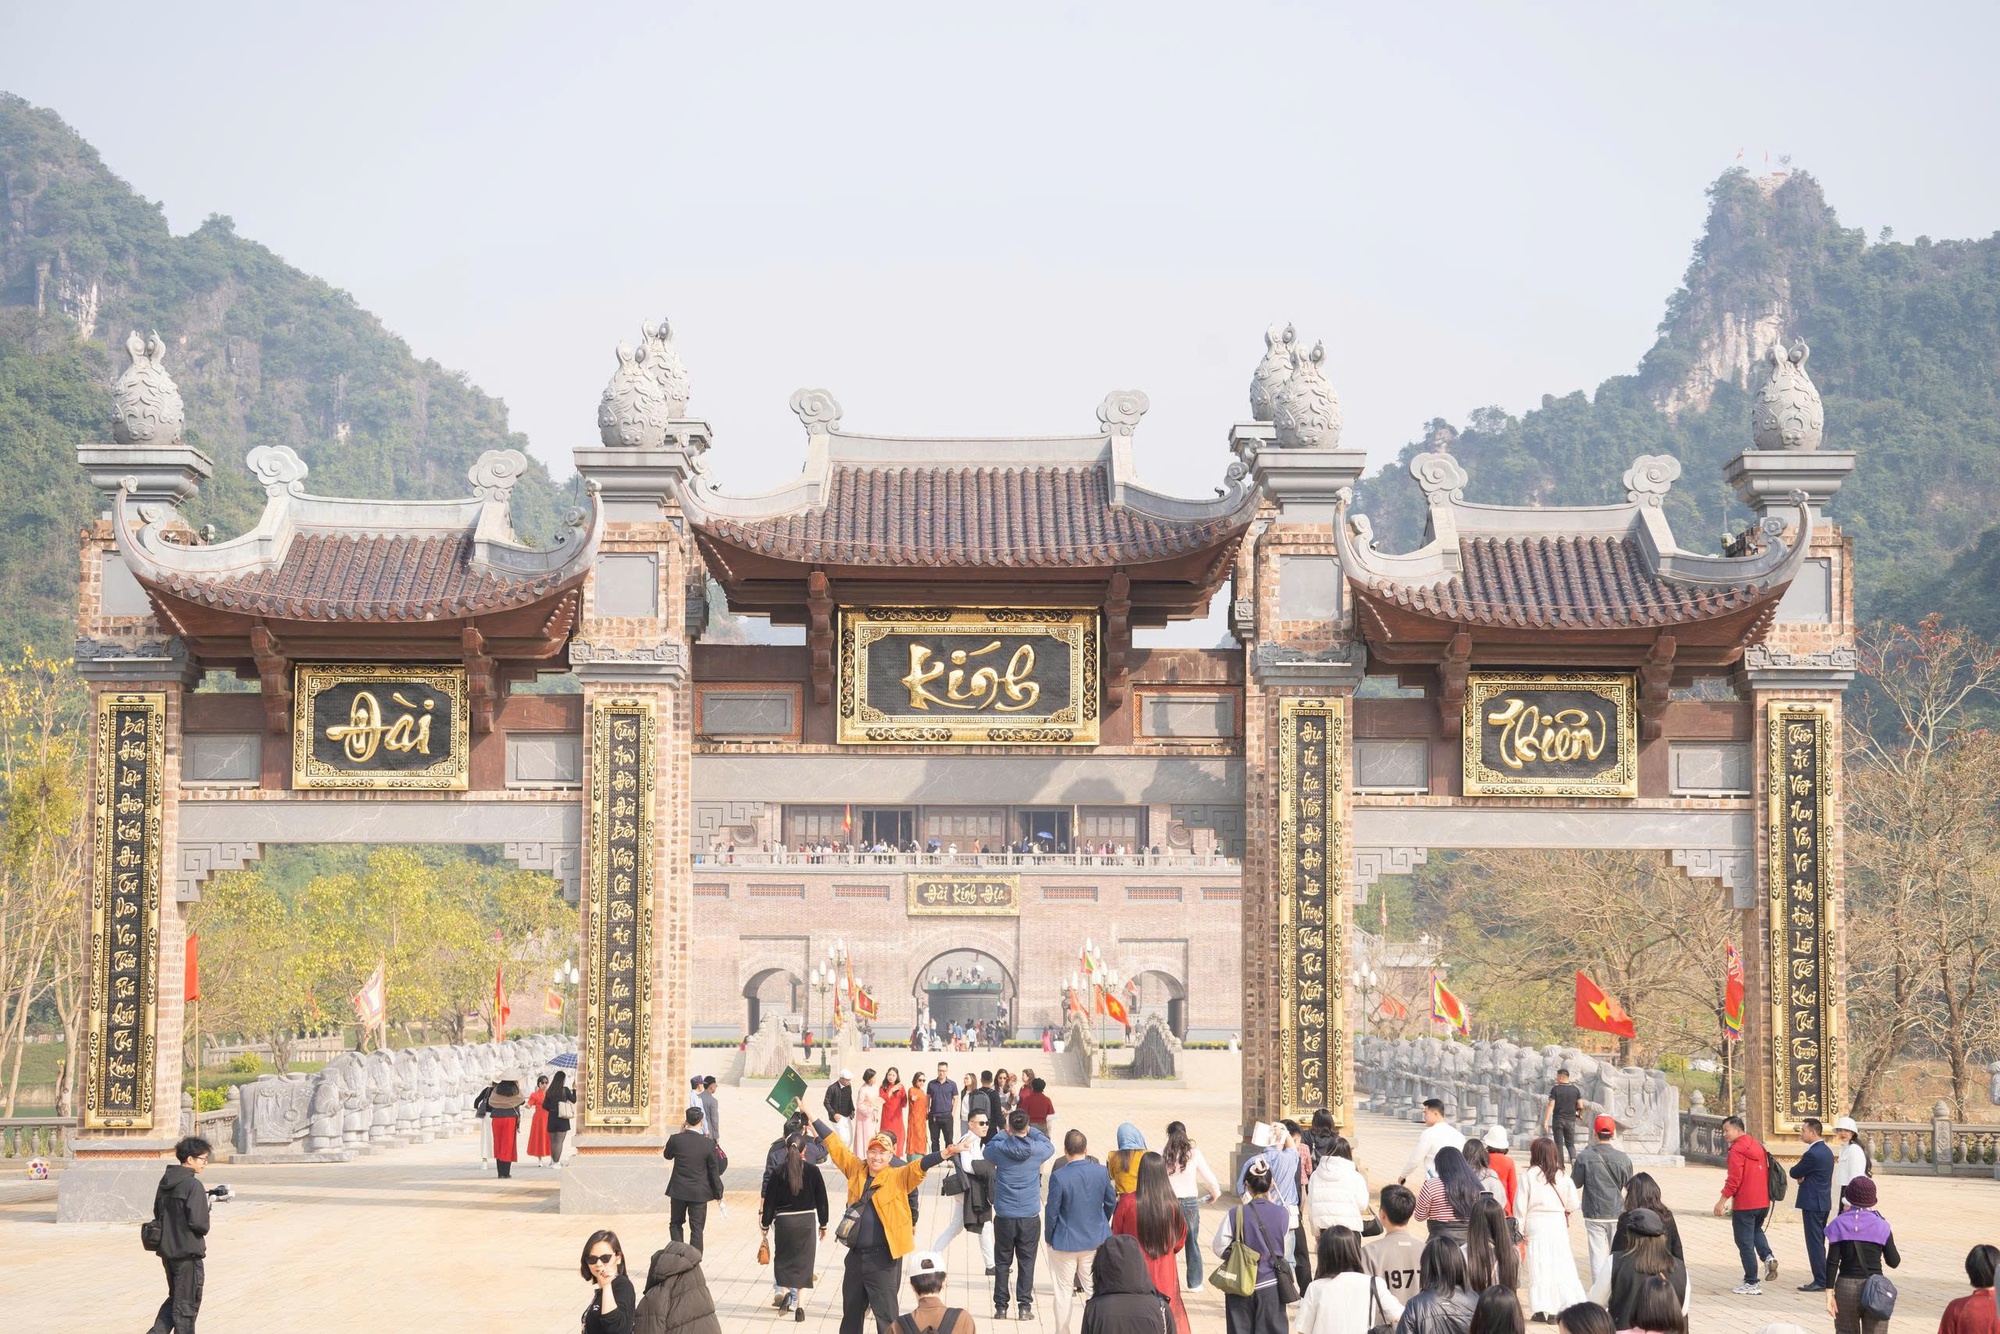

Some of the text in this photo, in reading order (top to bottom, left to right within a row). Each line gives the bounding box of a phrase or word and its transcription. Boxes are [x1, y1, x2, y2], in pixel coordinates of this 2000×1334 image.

[901, 641, 1040, 711] Kính
[121, 716, 145, 736] Bái
[326, 691, 435, 762] Đài
[1300, 721, 1323, 743] Địa
[1488, 698, 1606, 769] Thiên
[1788, 724, 1813, 745] Thiên
[118, 740, 146, 761] Đính
[120, 766, 142, 788] Lập
[1302, 771, 1319, 792] Gia
[1789, 774, 1813, 796] Việt
[116, 793, 144, 814] Điện
[1300, 797, 1322, 819] Viễn
[1790, 800, 1813, 822] Nam
[117, 819, 142, 841] Kính
[1792, 827, 1812, 850] Văn
[116, 846, 142, 867] Địa
[923, 883, 1005, 904] Đài Kính Địa
[1791, 879, 1814, 902] Anh
[115, 897, 138, 919] Dân
[606, 720, 636, 1103] Tràng An Đền Đài Bền Vững Cầu Thần Hộ Quốc Gia Muôn Năm Cường Thịnh
[1791, 905, 1815, 929] Hùng
[116, 924, 136, 946] Vạn
[1299, 927, 1324, 949] Thánh
[114, 977, 135, 999] Phú
[1298, 979, 1324, 1001] Xuất
[1791, 984, 1816, 1008] Khai
[112, 1002, 136, 1026] Quý
[1299, 1004, 1325, 1029] Chúng
[113, 1030, 132, 1051] Thọ
[109, 1055, 135, 1078] Khang
[1301, 1057, 1322, 1079] Tài
[110, 1083, 132, 1104] Ninh
[1301, 1082, 1323, 1104] Nhân
